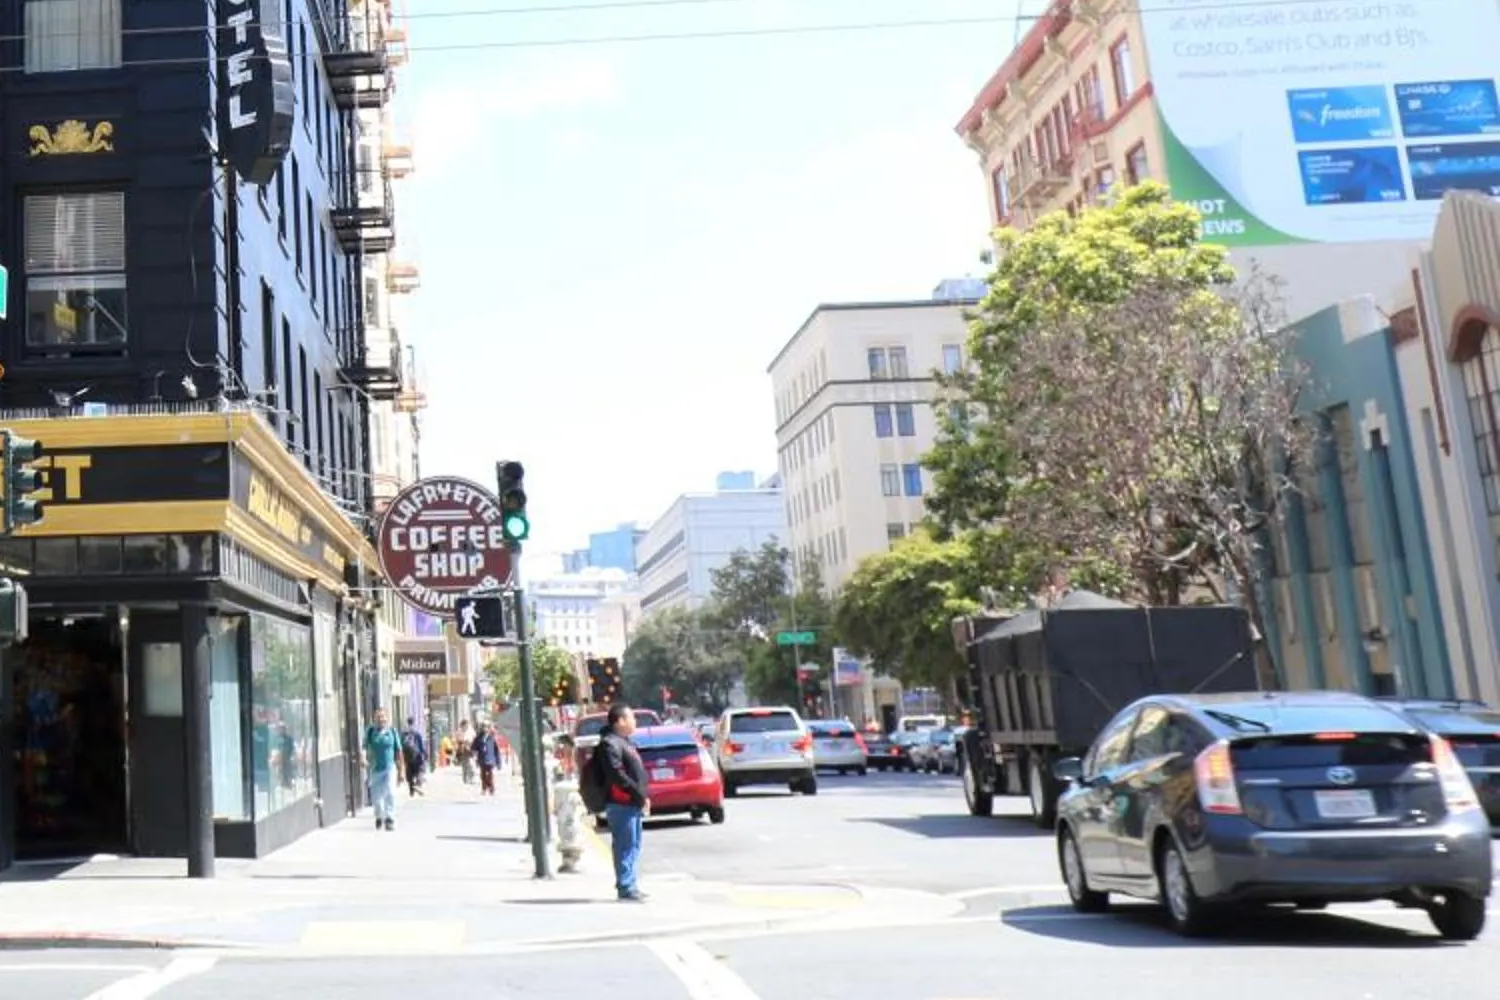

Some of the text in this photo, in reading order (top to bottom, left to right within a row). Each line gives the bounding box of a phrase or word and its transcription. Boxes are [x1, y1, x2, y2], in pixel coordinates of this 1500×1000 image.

[1344, 1, 1391, 21] such
[1306, 31, 1351, 50] Club
[1353, 29, 1392, 48] and
[1320, 104, 1381, 128] freedom
[1197, 219, 1246, 238] EWS
[391, 482, 500, 526] LAFAYETTE
[390, 525, 504, 551] COFFEE
[414, 552, 485, 577] SHOP
